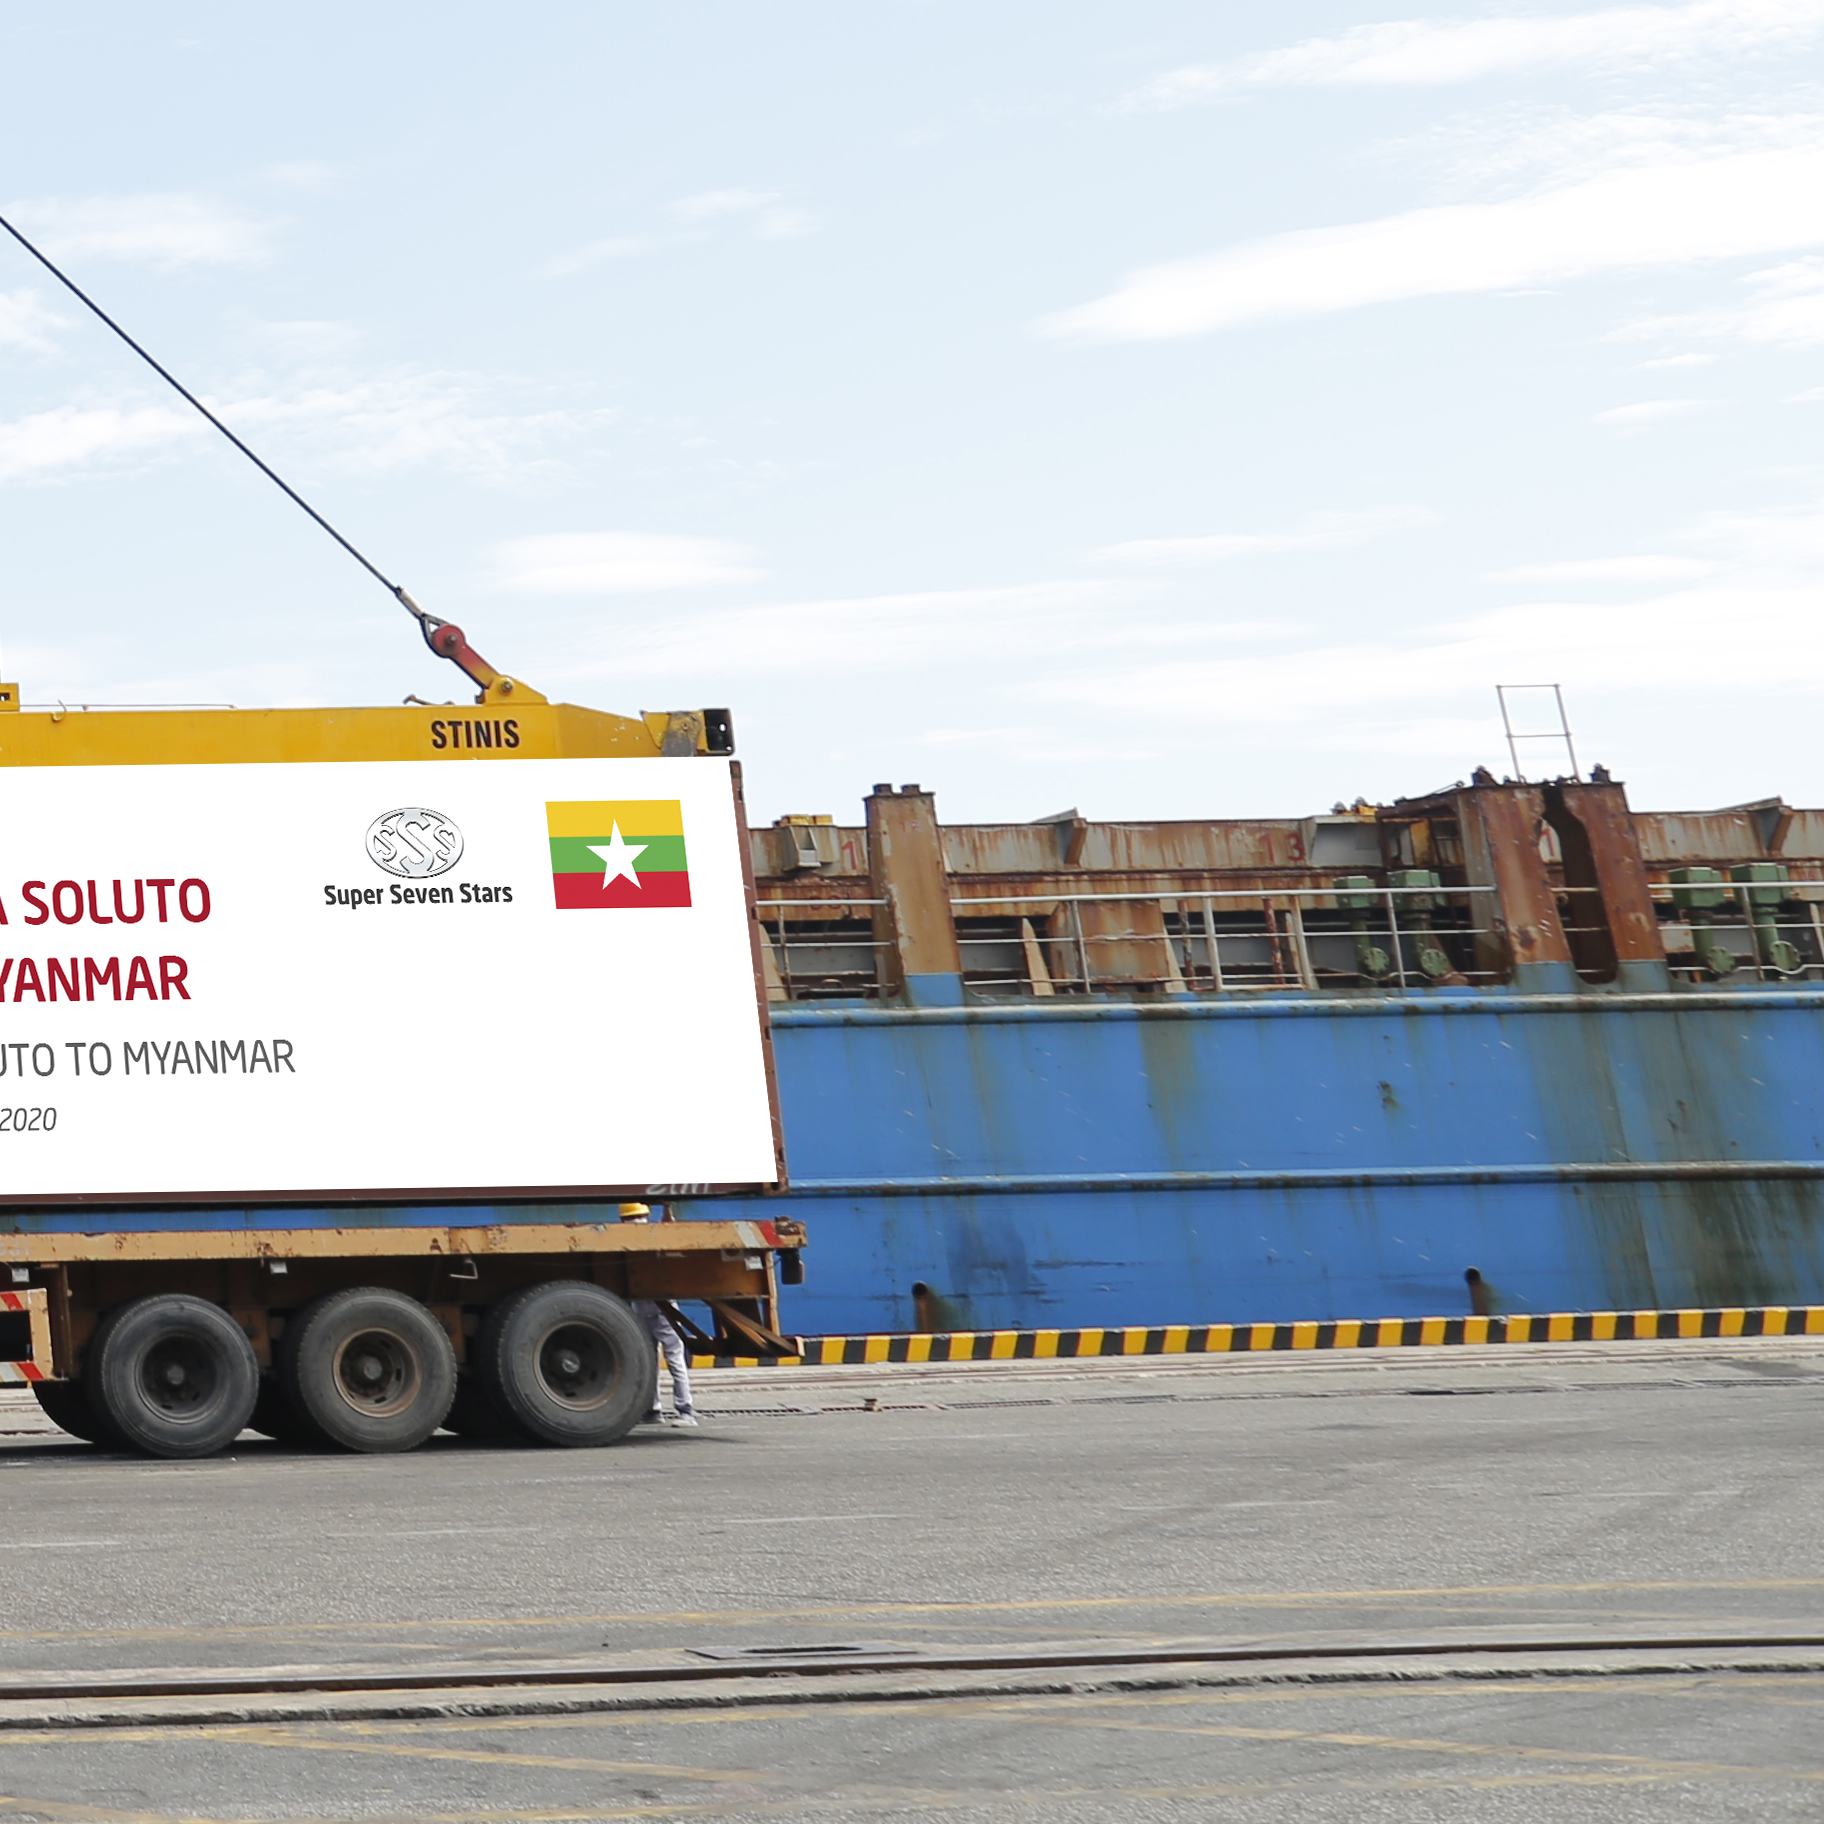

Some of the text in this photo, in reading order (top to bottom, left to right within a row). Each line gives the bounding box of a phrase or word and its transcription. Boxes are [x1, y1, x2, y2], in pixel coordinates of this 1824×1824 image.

[431, 719, 521, 750] STINIS
[22, 878, 210, 925] SOLUTO
[324, 883, 513, 910] Super Seven Stars
[65, 1042, 111, 1076] TO
[124, 1039, 295, 1075] MYANMAR
[0, 1108, 56, 1131] 2020
